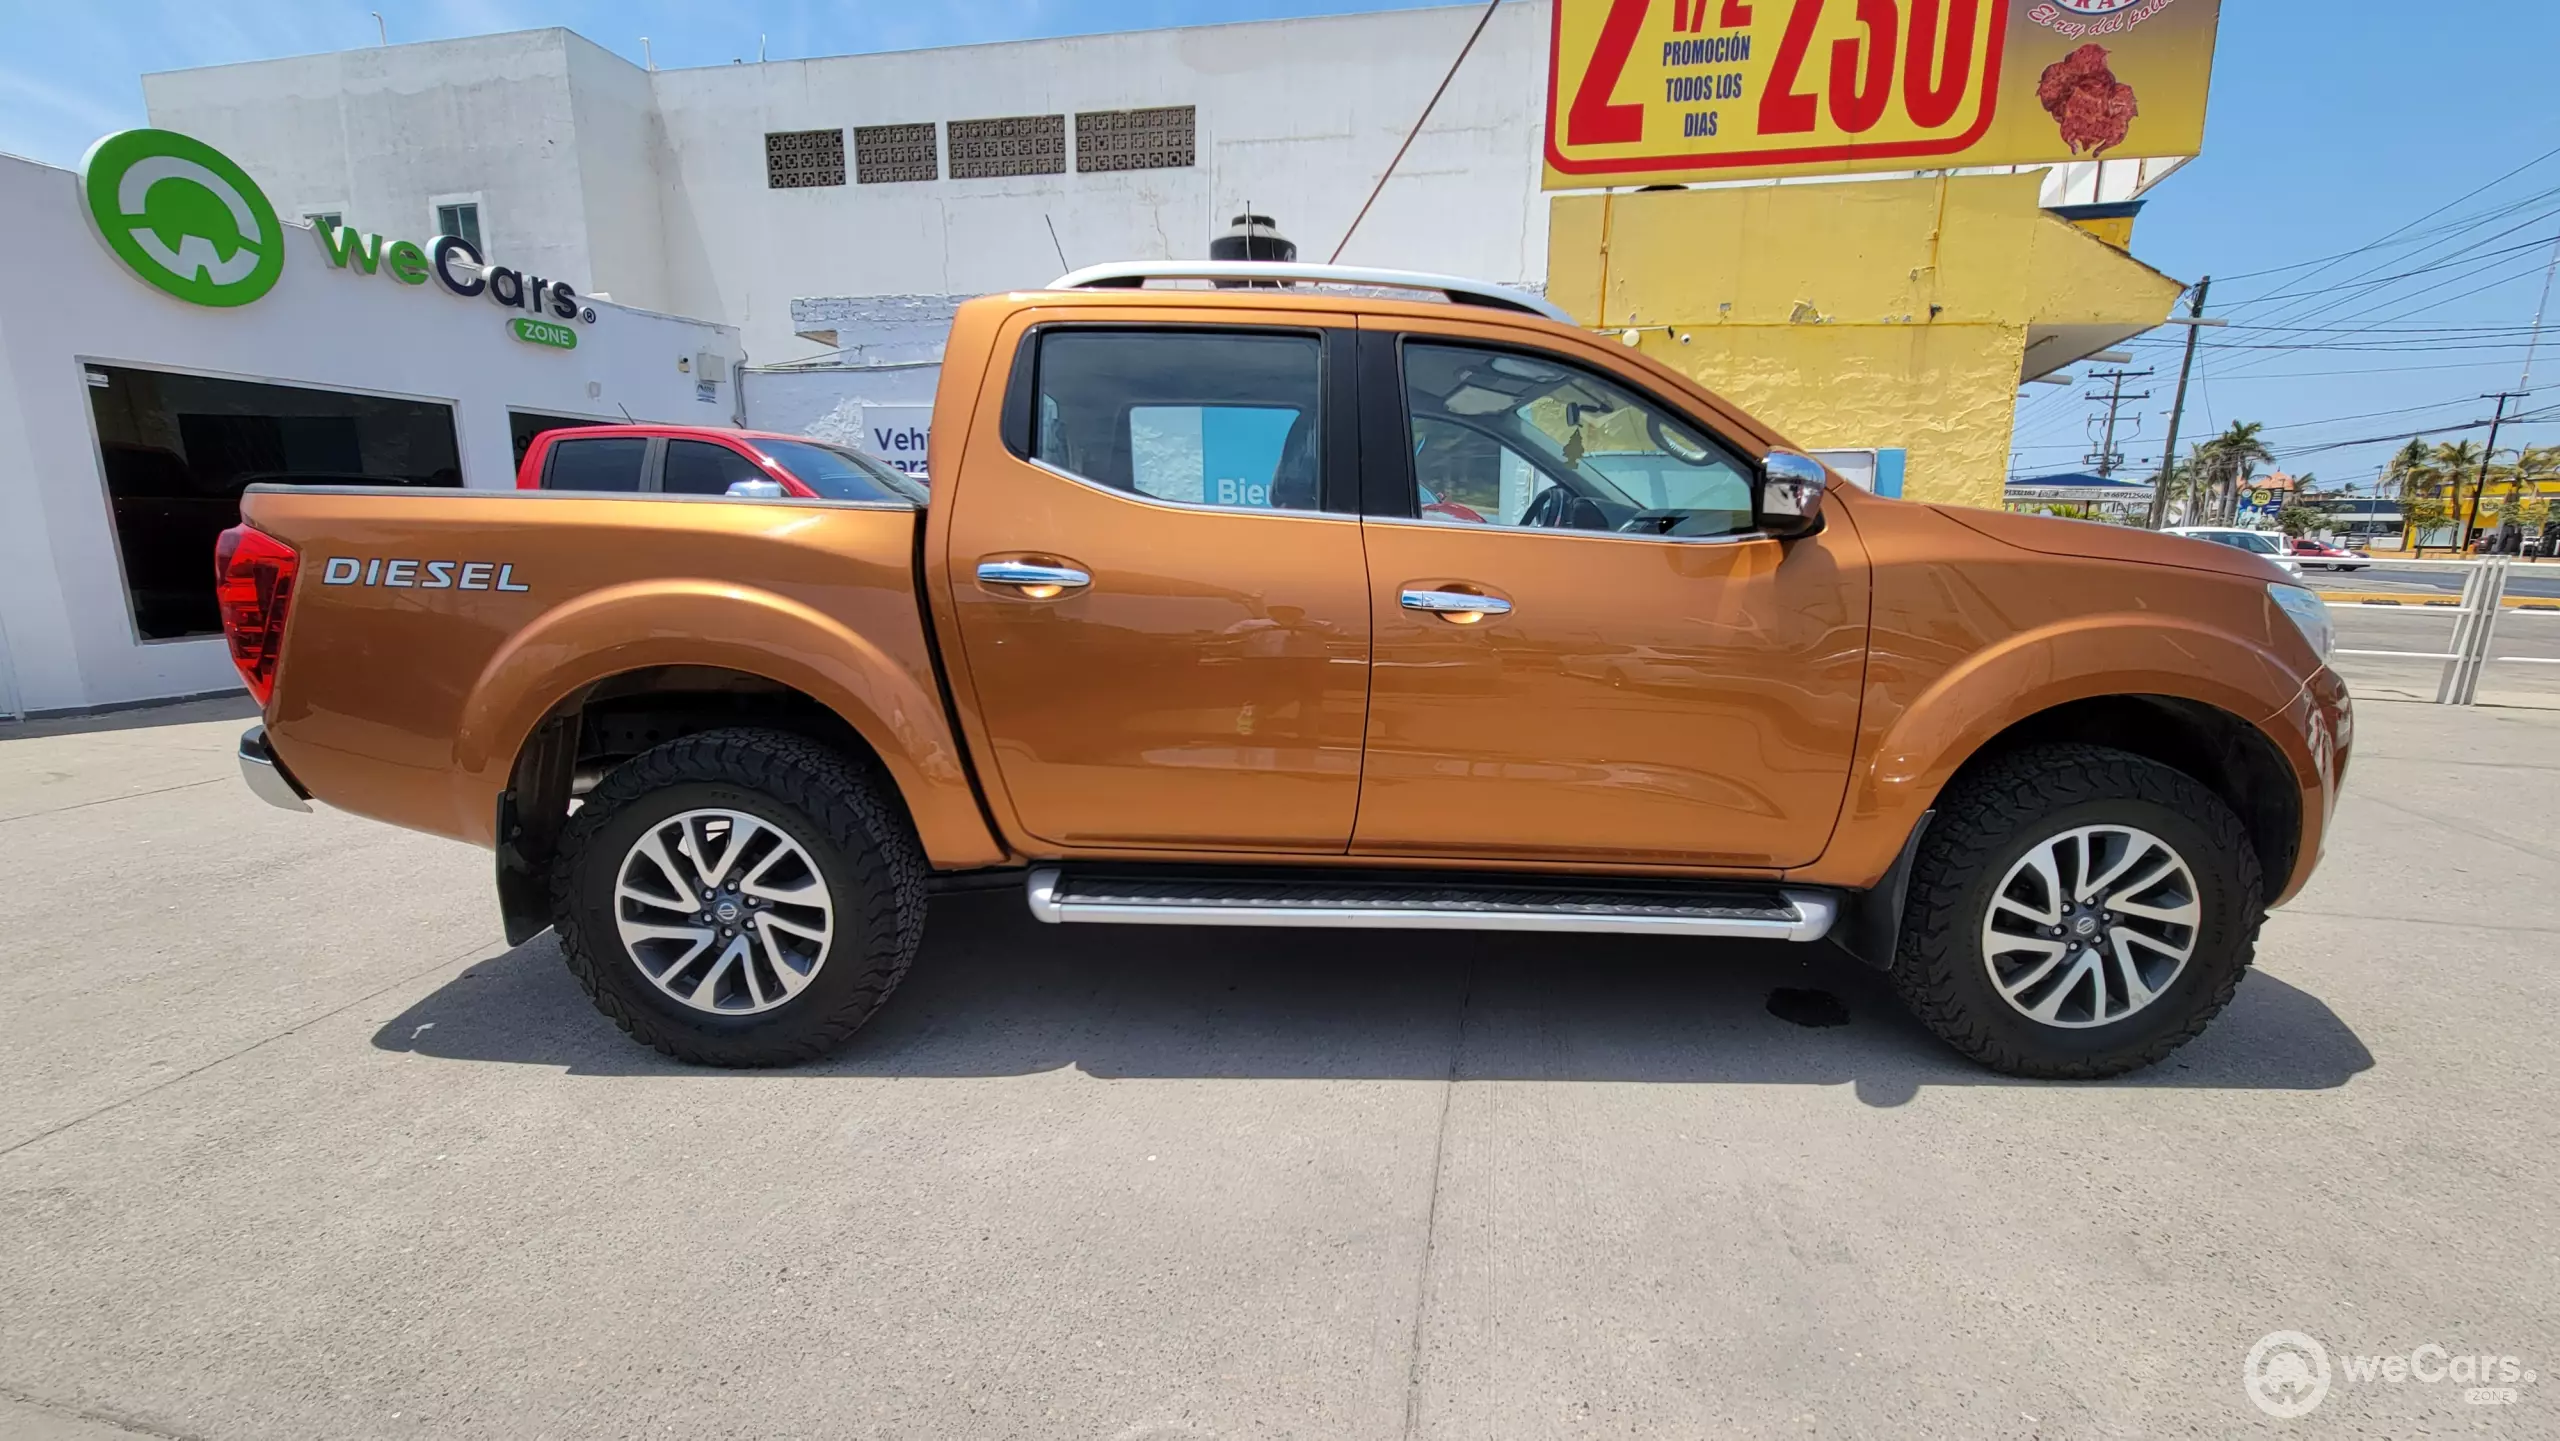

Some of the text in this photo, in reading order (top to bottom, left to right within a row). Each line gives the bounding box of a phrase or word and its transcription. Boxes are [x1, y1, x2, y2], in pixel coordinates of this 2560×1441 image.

[2028, 4, 2059, 26] El
[2054, 20, 2085, 40] rey
[2088, 13, 2123, 35] del
[2127, 0, 2174, 31] pol
[1662, 31, 1751, 67] PROMOCIÓN
[1665, 73, 1743, 103] TODOS LOS
[1683, 111, 1718, 138] DIAS
[523, 321, 571, 346] ZONE
[322, 556, 531, 593] DIESEL
